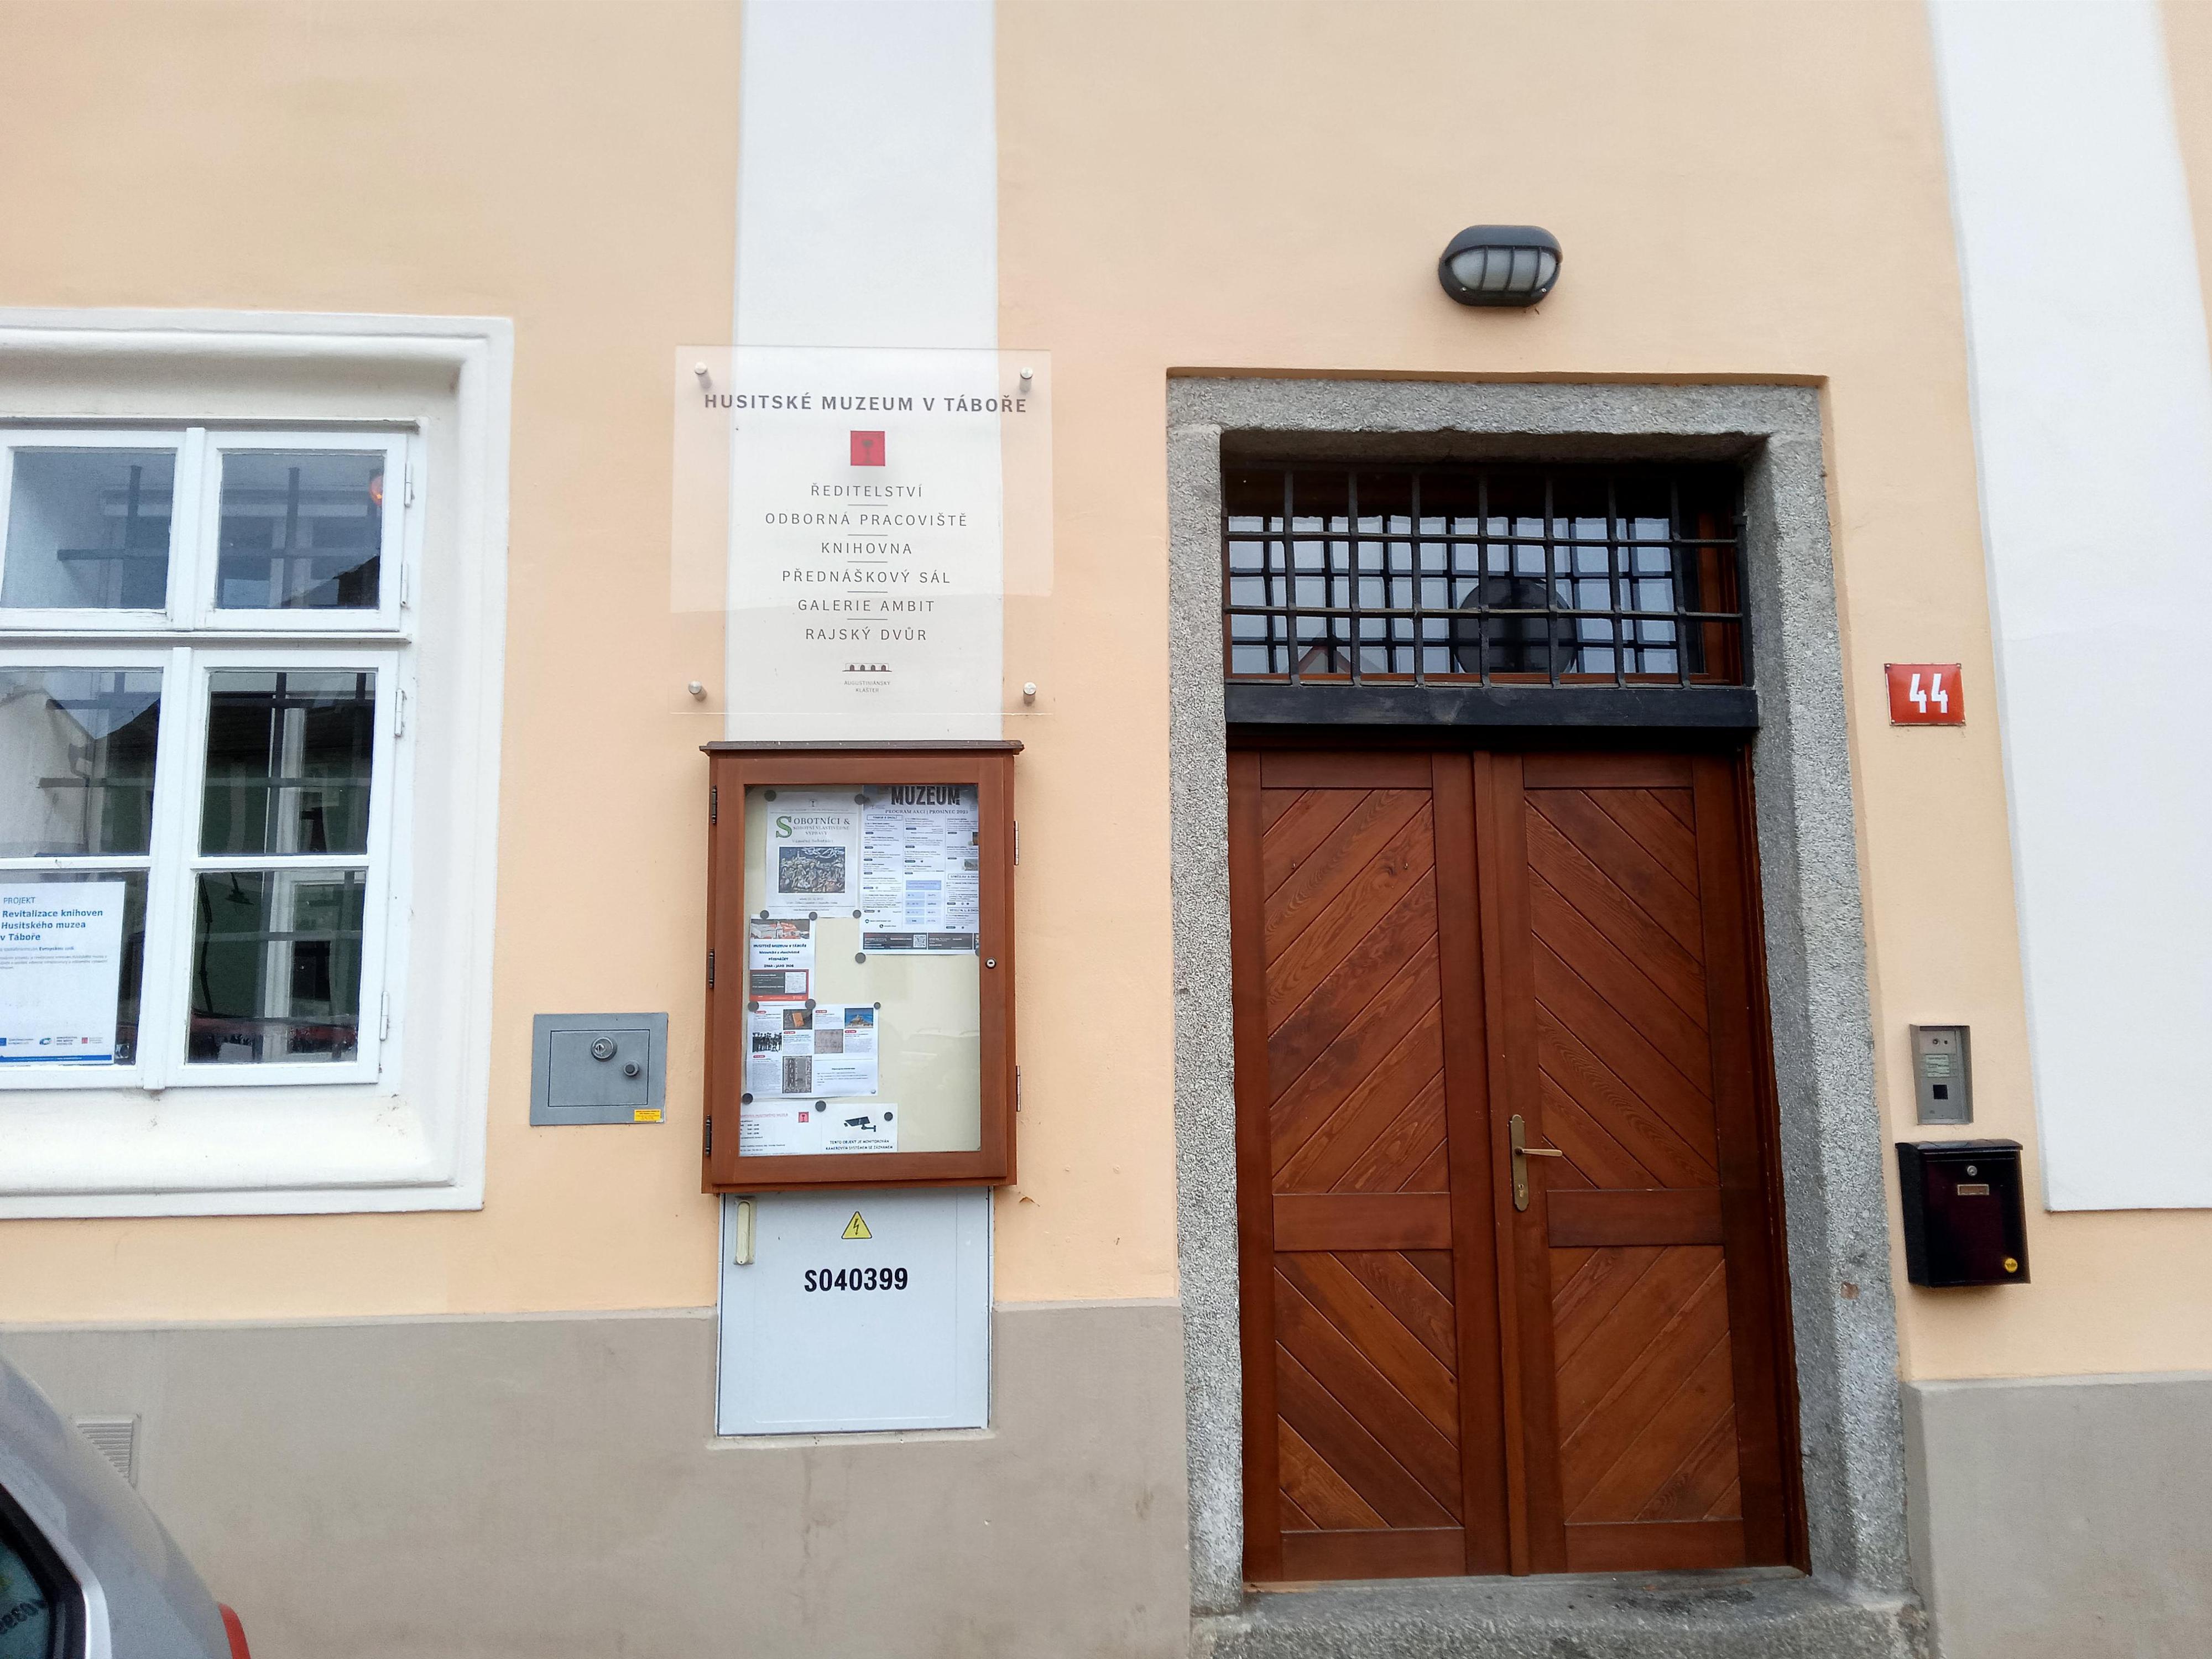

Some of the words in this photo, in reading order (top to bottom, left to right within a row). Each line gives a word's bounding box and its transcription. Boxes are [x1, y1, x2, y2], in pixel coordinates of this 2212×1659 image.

[705, 392, 812, 410] HUSITSKÉ
[822, 396, 913, 411] MUZEUM
[922, 397, 935, 411] V
[943, 394, 1026, 413] TÁBOŘE
[811, 483, 922, 498] ŘEDITELSTVÍ
[765, 512, 851, 526] ODBORNÁ
[860, 512, 967, 527] PRACOVIŠTĚ
[821, 542, 912, 554] KNIHOVNA
[782, 568, 910, 583] PŘEDNÁŠKOVÝ
[919, 570, 951, 584] SÁL
[797, 599, 871, 612] GALERIE
[880, 600, 935, 612] AMBIT
[806, 625, 871, 640] RAJSKÝ
[880, 626, 927, 641] DVŮR
[1910, 673, 1948, 713] 44
[891, 786, 961, 805] MUZEUM
[804, 1267, 909, 1292] S040399
